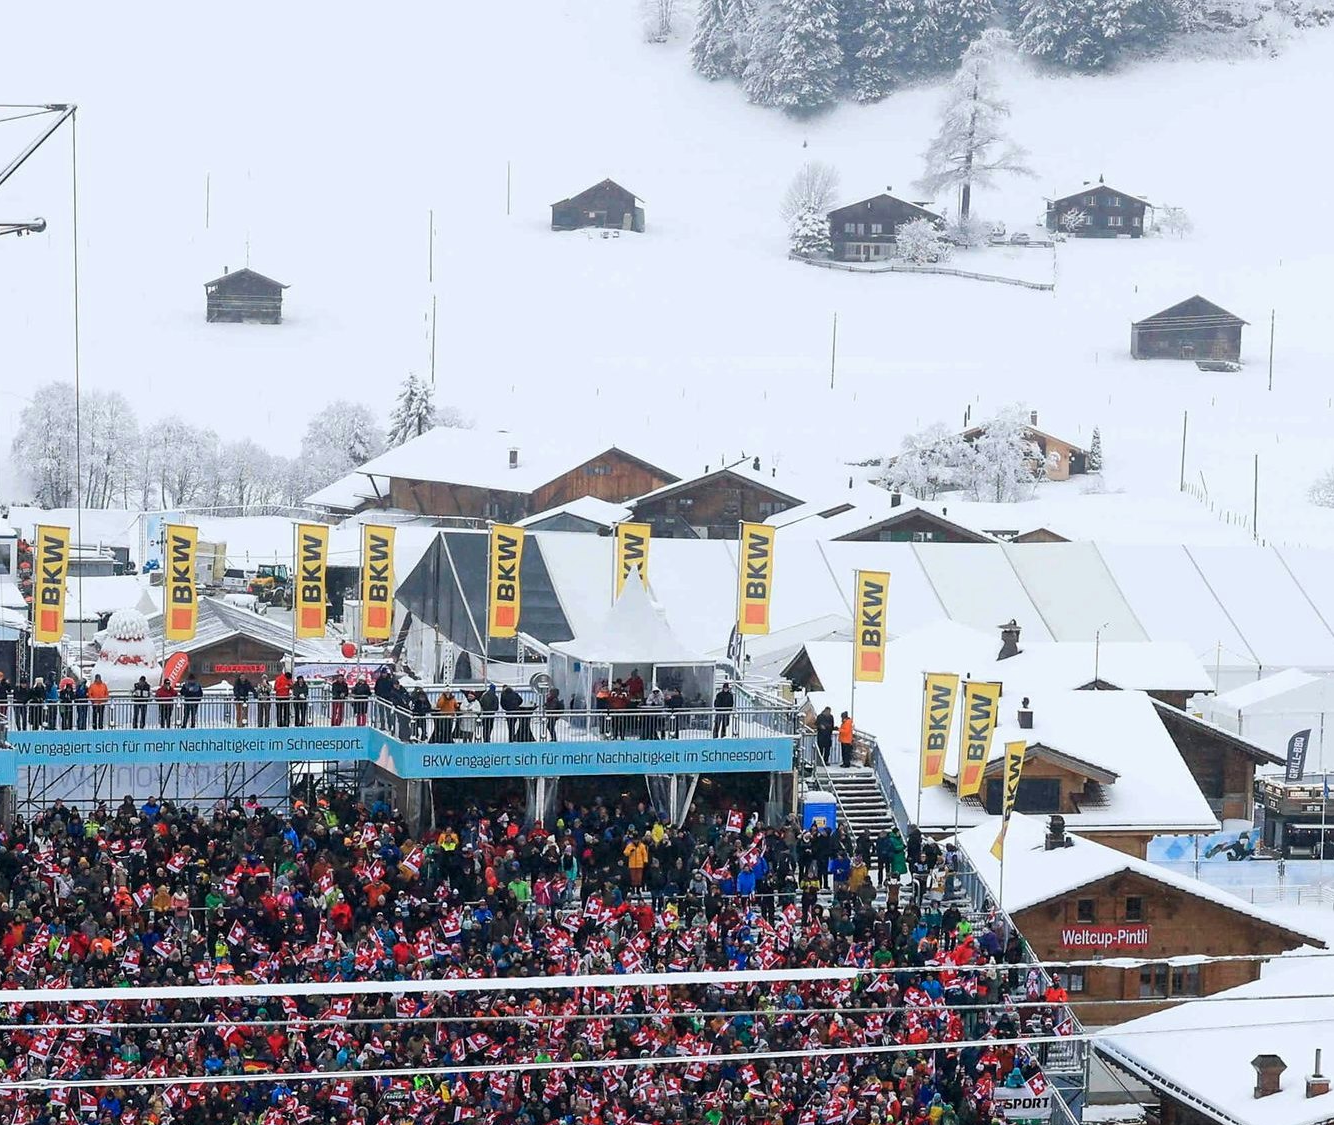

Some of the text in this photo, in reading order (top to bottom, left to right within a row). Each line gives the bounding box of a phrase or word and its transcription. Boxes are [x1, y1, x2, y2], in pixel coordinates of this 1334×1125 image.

[41, 535, 64, 606] BKW
[172, 535, 192, 604] BKW
[302, 533, 323, 603] BKW
[369, 533, 388, 603] BKW
[497, 533, 517, 601] BKW
[746, 532, 769, 599] BKW
[862, 580, 884, 647] BKW
[35, 742, 91, 757] engagiert
[95, 741, 119, 753] sich
[122, 740, 140, 752] für
[144, 740, 175, 752] mehr
[179, 739, 265, 753] Nachhaltigkeit
[269, 738, 283, 751] im
[287, 738, 364, 753] Schneesport.
[927, 683, 952, 751] BKW
[967, 693, 992, 761] BKW
[423, 750, 776, 770] BKW engagiert sich für mehr Nachhaltigkeit im Schneesport.
[1062, 929, 1148, 948] Weltcup-Pintli
[1004, 1097, 1050, 1110] SPORT
